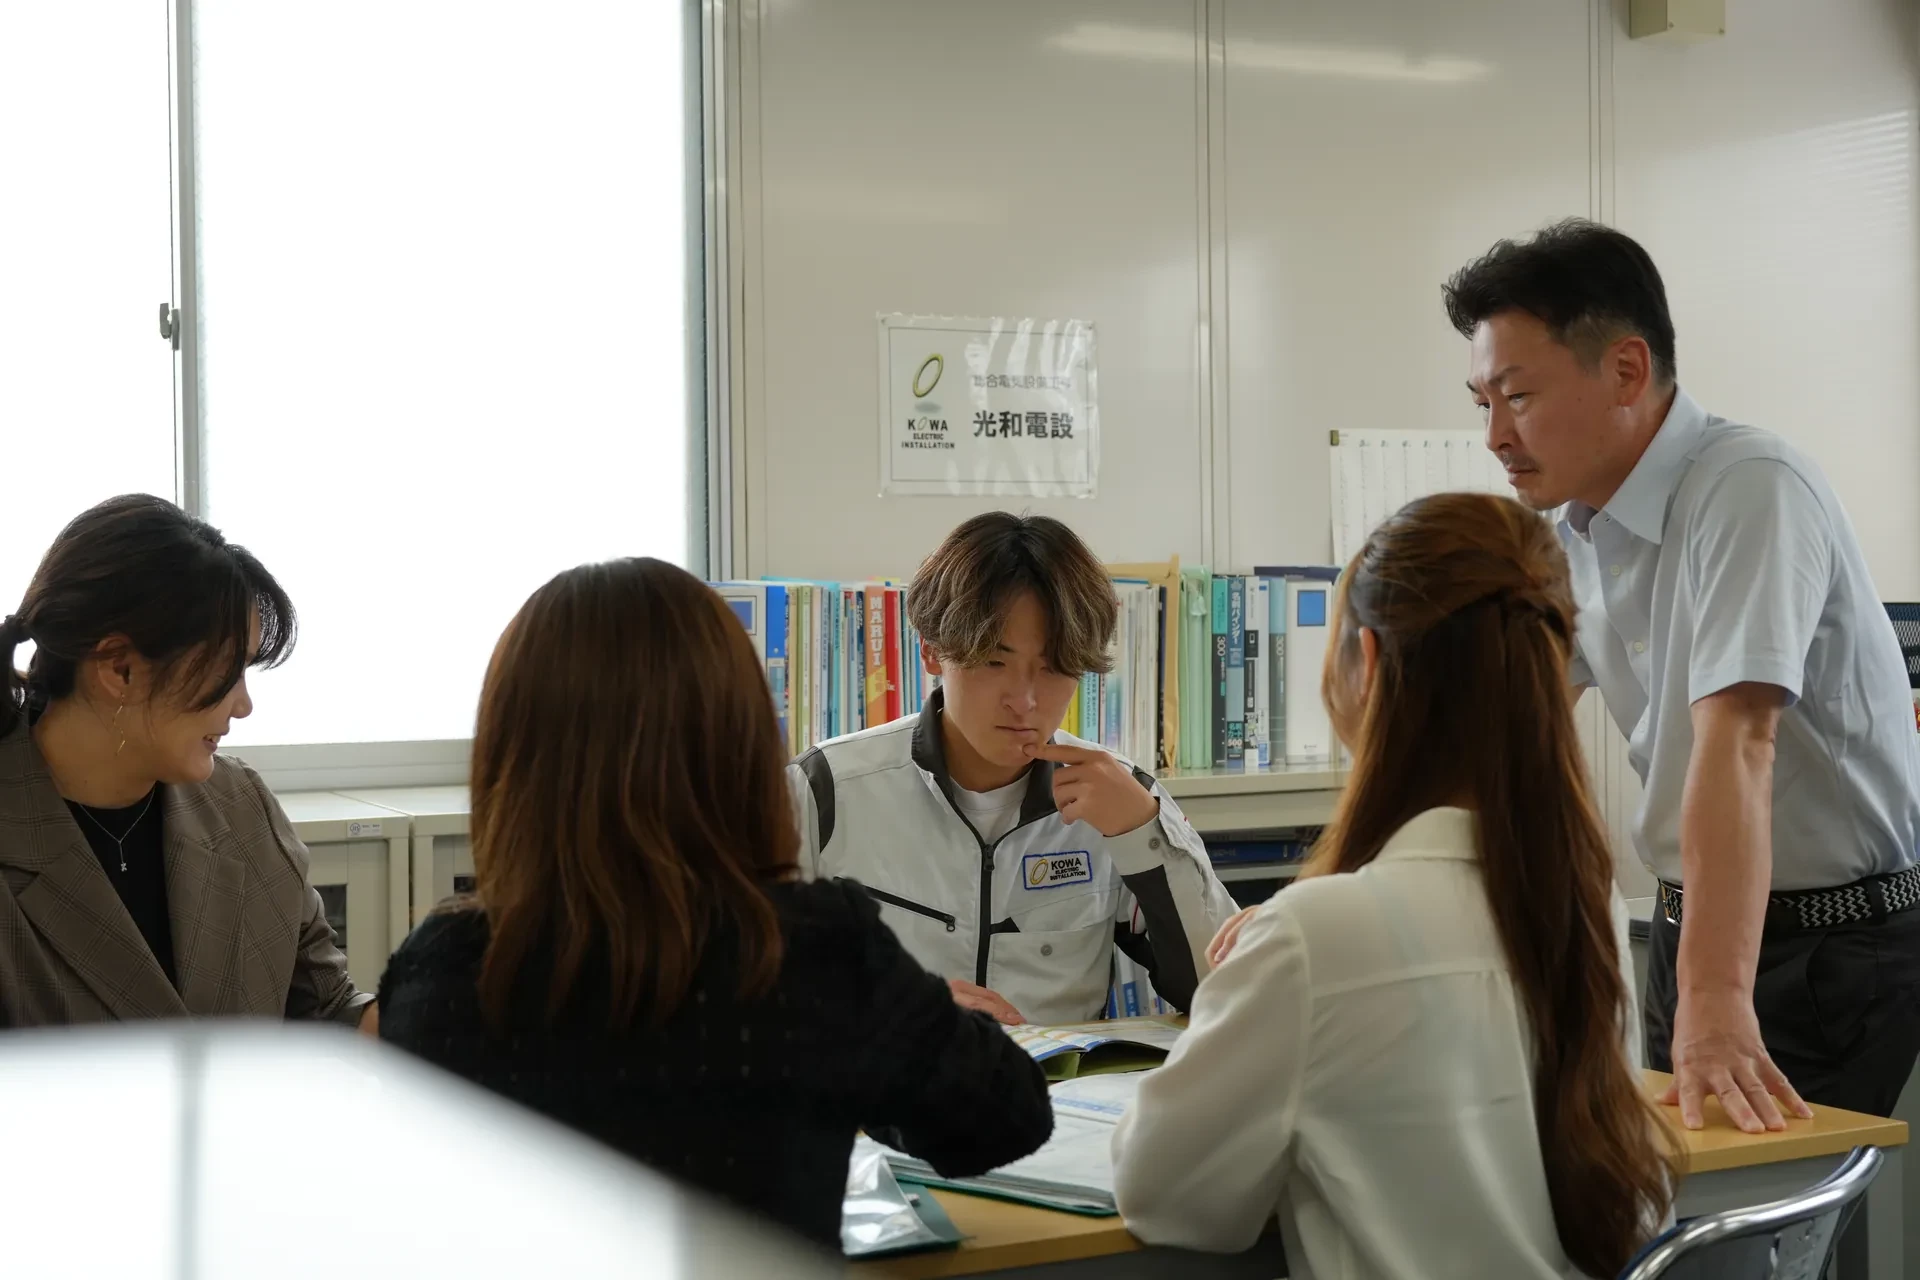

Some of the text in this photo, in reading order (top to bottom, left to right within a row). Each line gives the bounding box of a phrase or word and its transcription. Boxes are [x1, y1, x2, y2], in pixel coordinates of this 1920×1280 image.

[973, 410, 1074, 440] 光和電設
[901, 442, 955, 450] INSTALLATION
[870, 596, 883, 666] MARUI
[1217, 635, 1226, 656] 300
[1228, 738, 1242, 747] 500
[1051, 857, 1082, 870] KOWA
[1050, 871, 1086, 881] INSTALLATION
